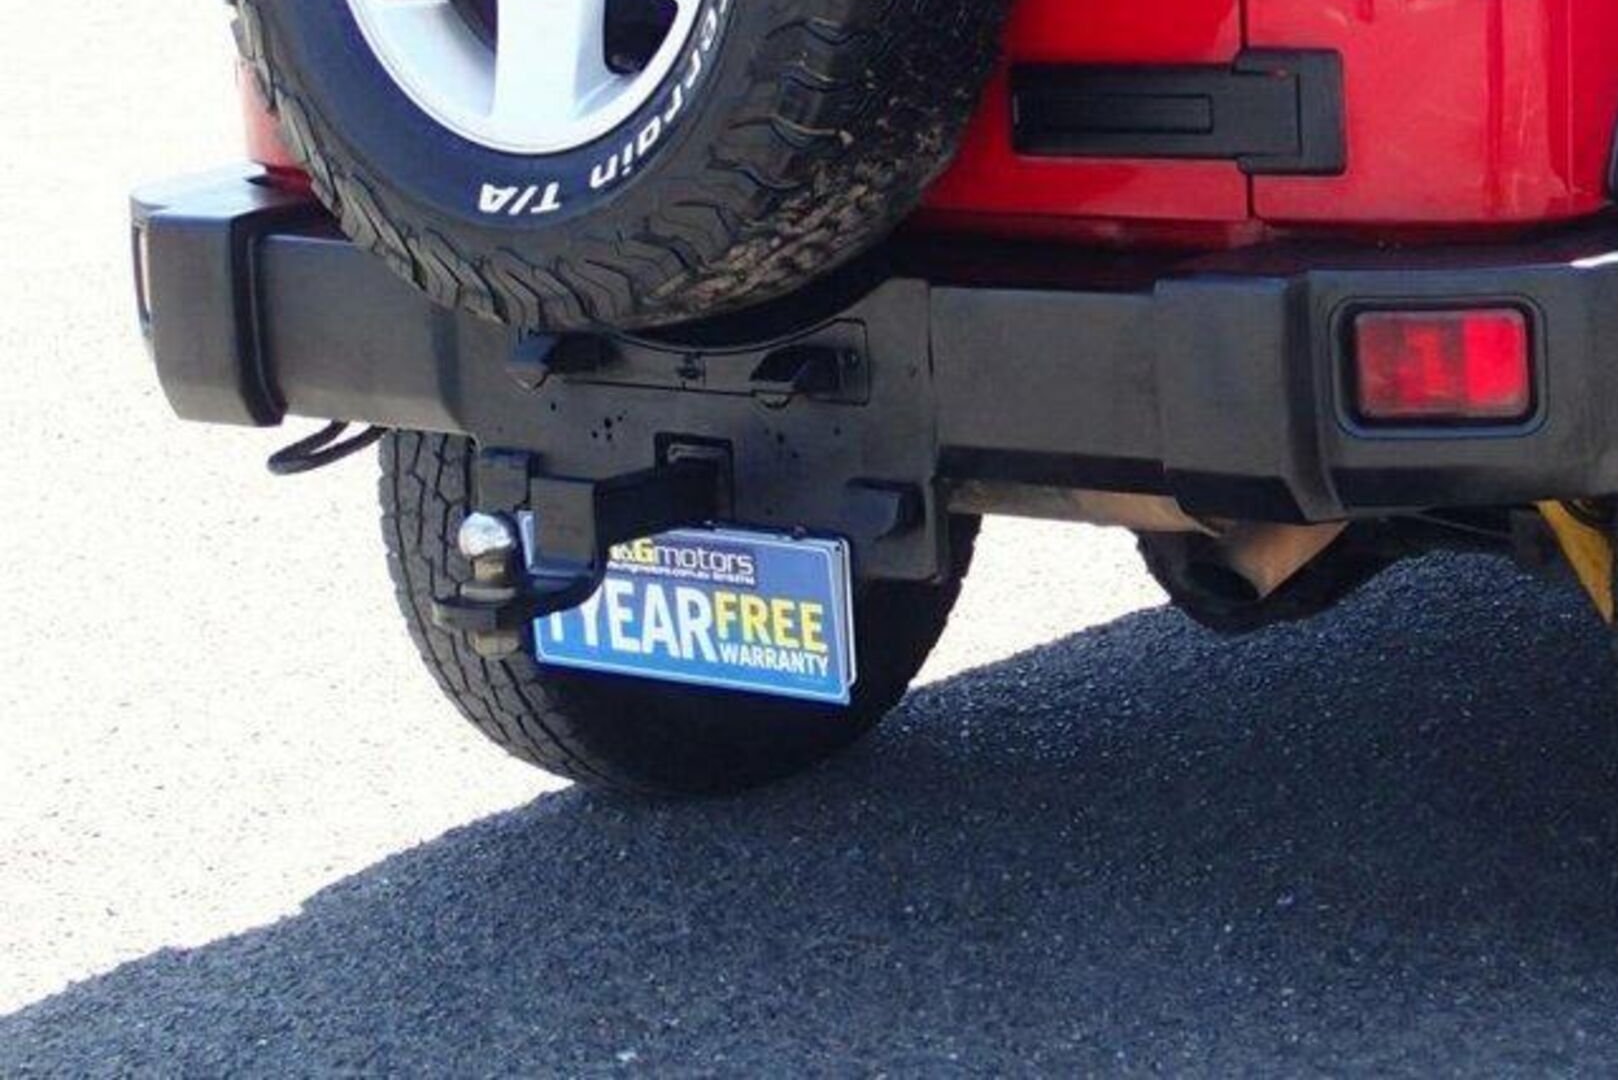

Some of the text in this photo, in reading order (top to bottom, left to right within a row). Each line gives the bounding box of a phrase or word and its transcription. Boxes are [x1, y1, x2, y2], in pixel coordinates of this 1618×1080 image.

[479, 181, 563, 216] T/A
[714, 590, 828, 654] FREE
[717, 641, 829, 678] WARRANTY
